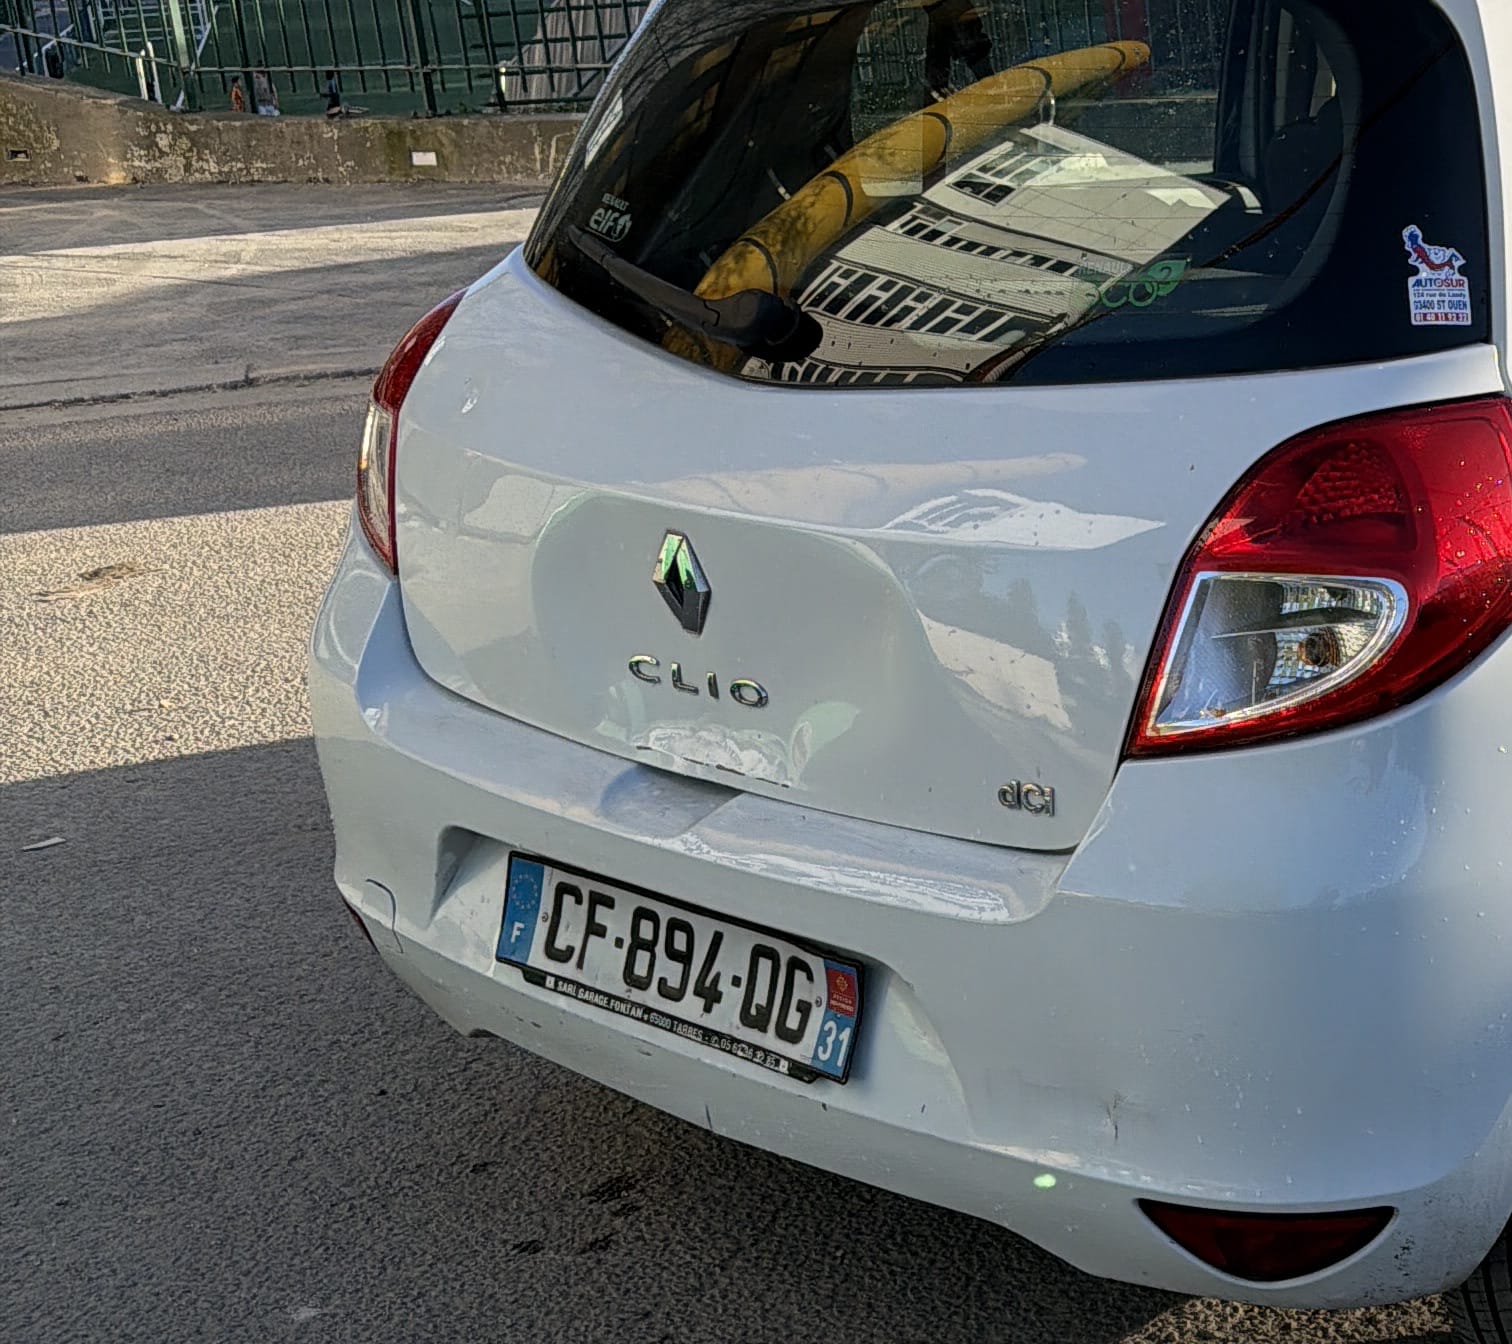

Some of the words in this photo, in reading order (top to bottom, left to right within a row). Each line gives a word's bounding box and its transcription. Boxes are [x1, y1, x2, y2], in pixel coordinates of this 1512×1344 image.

[589, 207, 621, 234] elf
[1411, 278, 1466, 288] AUTOSUR
[1437, 299, 1446, 310] ST
[1447, 299, 1468, 311] OUEN
[628, 655, 769, 708] CLIO
[510, 922, 525, 944] F
[557, 980, 576, 995] SARL
[578, 988, 609, 1009] GARAGE
[609, 999, 644, 1019] FONTAN
[818, 1020, 851, 1067] 31
